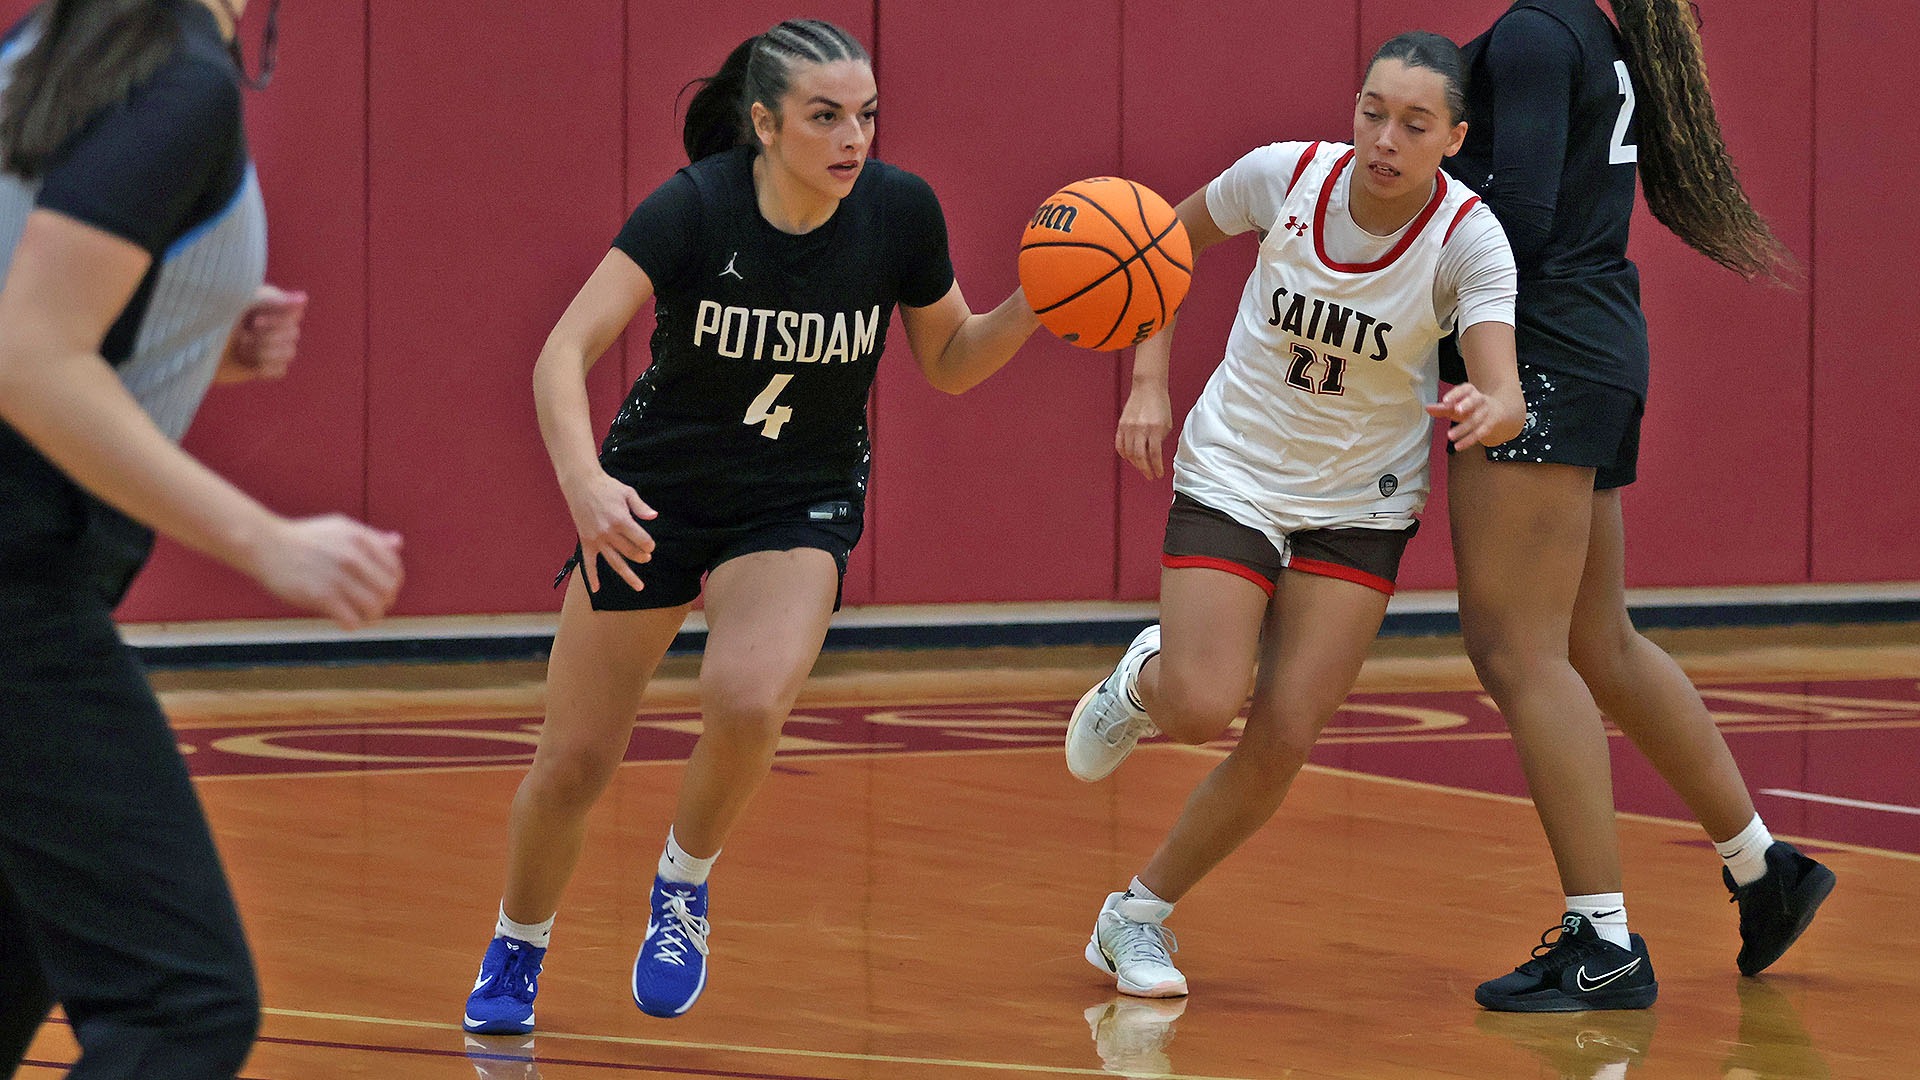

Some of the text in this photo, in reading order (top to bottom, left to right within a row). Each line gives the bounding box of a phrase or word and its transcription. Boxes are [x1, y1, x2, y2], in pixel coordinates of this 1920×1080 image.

[694, 300, 880, 364] POTSDAM
[1268, 287, 1393, 362] SAINTS
[1285, 342, 1346, 396] 21
[743, 373, 794, 440] 4
